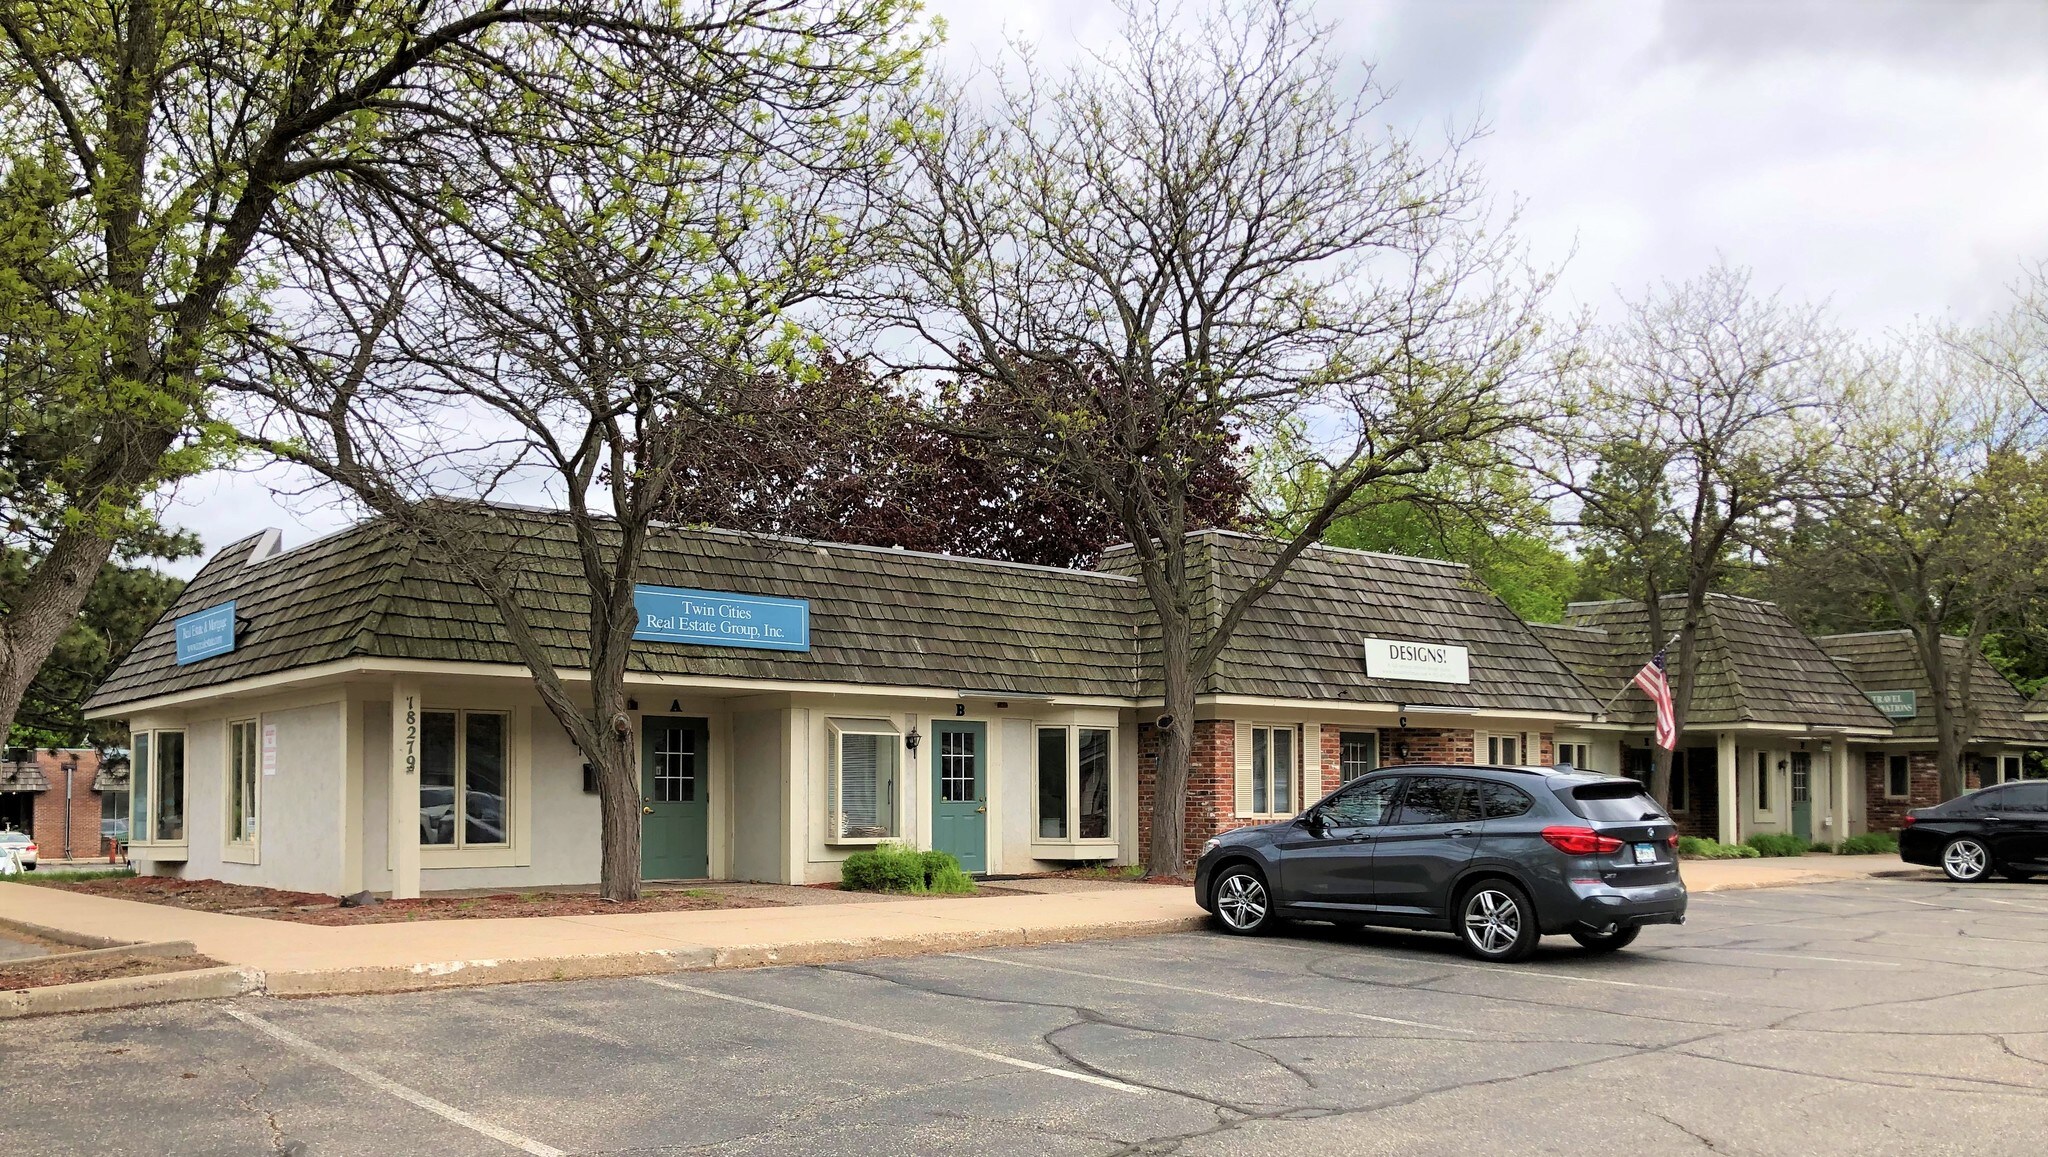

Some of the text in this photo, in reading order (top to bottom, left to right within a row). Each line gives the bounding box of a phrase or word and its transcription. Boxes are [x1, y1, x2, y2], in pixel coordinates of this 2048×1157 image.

[682, 601, 751, 620] Twin Cities
[646, 614, 785, 639] Real Estate Group, Inc.
[1389, 644, 1447, 664] DESIGNS!
[669, 699, 683, 712] A
[955, 703, 965, 716] B
[1878, 704, 1913, 712] VATIONS
[1399, 717, 1407, 728] C
[406, 696, 416, 774] 18279
